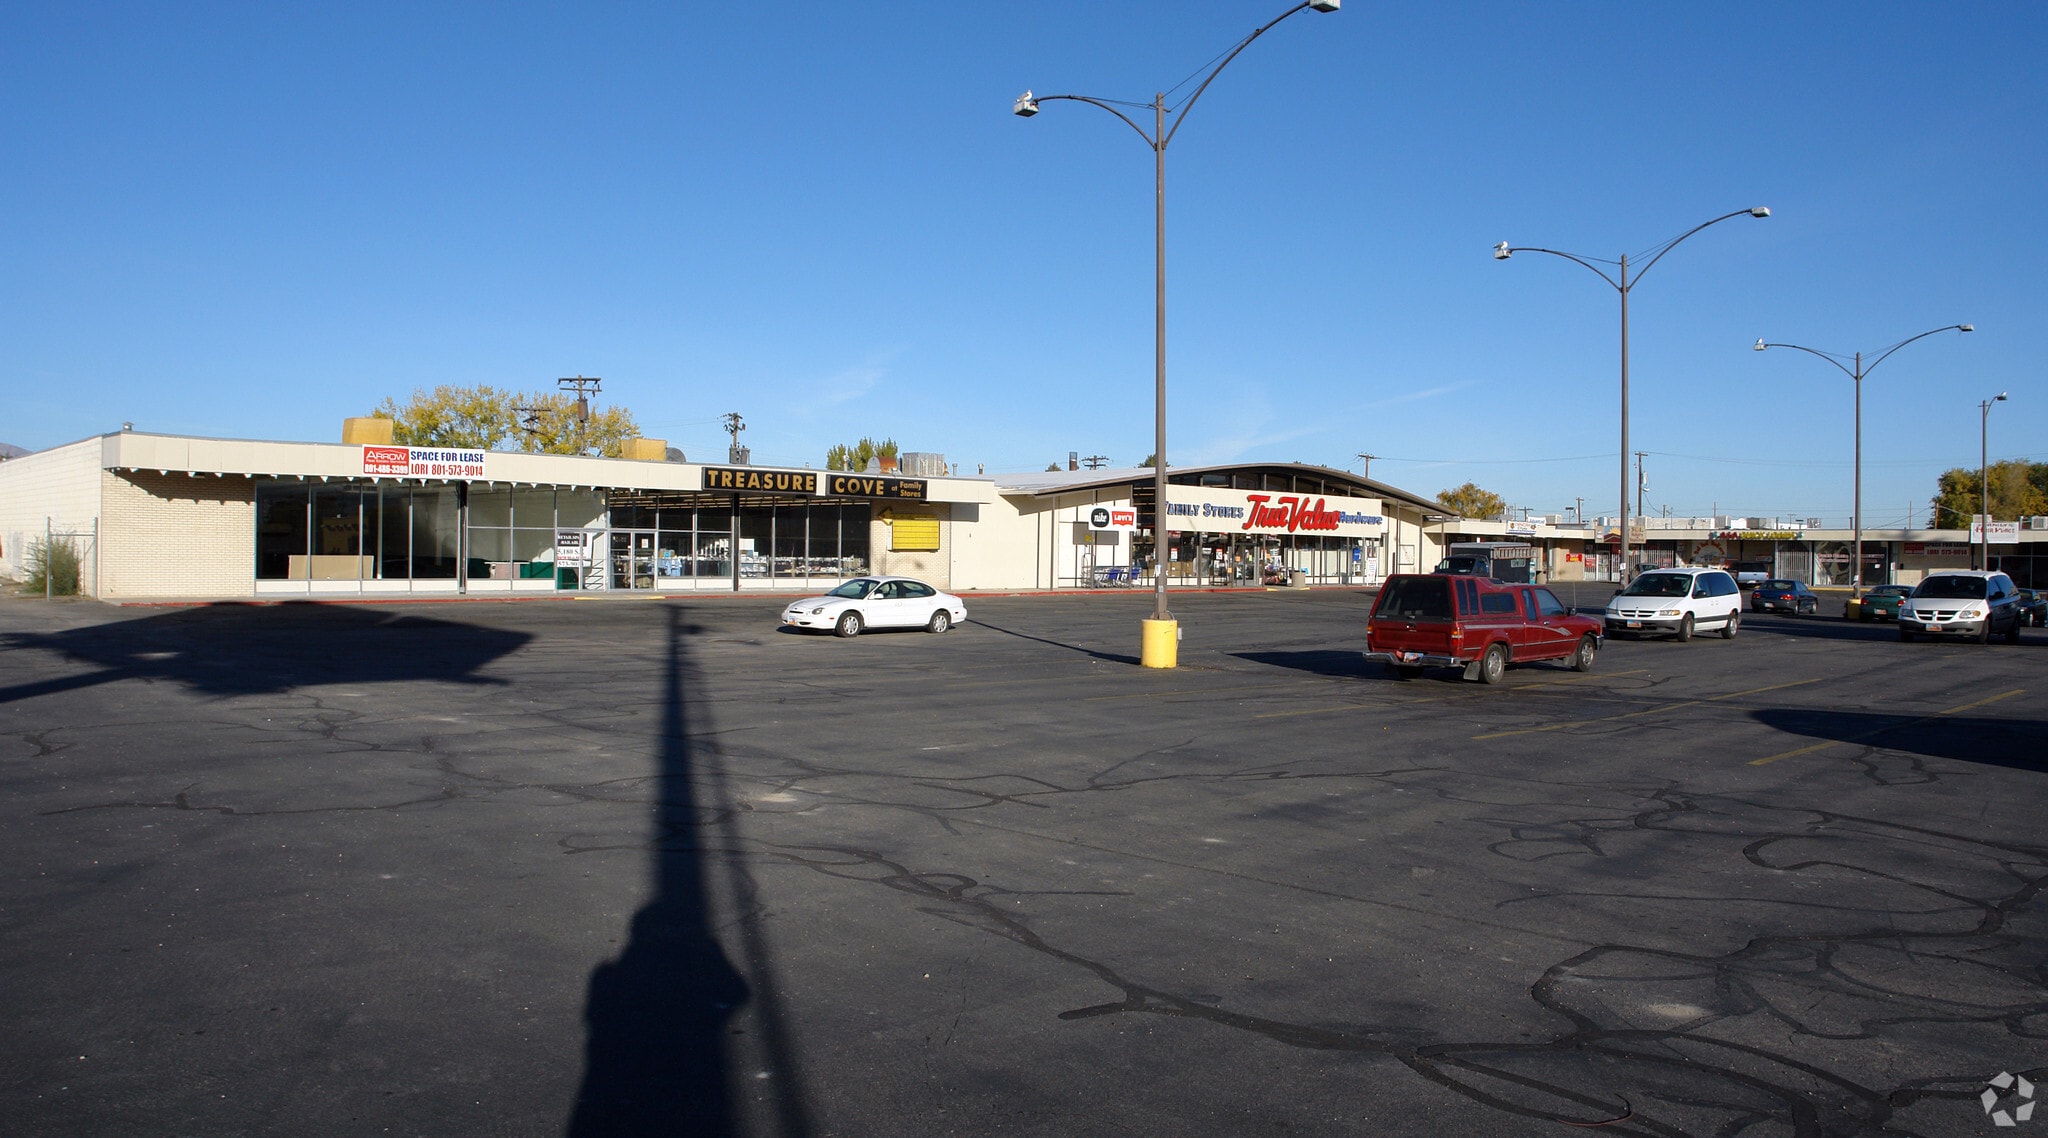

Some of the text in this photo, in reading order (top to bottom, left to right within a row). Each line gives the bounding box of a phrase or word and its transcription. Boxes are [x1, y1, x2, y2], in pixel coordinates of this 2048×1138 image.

[366, 450, 406, 461] ARROW
[410, 450, 484, 463] SPACE FOR LEASE
[411, 463, 483, 476] LORI 801-573-9014
[707, 470, 815, 491] TREASURE
[834, 477, 885, 495] COVE
[899, 480, 922, 491] Family
[899, 489, 921, 498] Stores
[1241, 494, 1289, 531] True
[1277, 496, 1340, 533] Value
